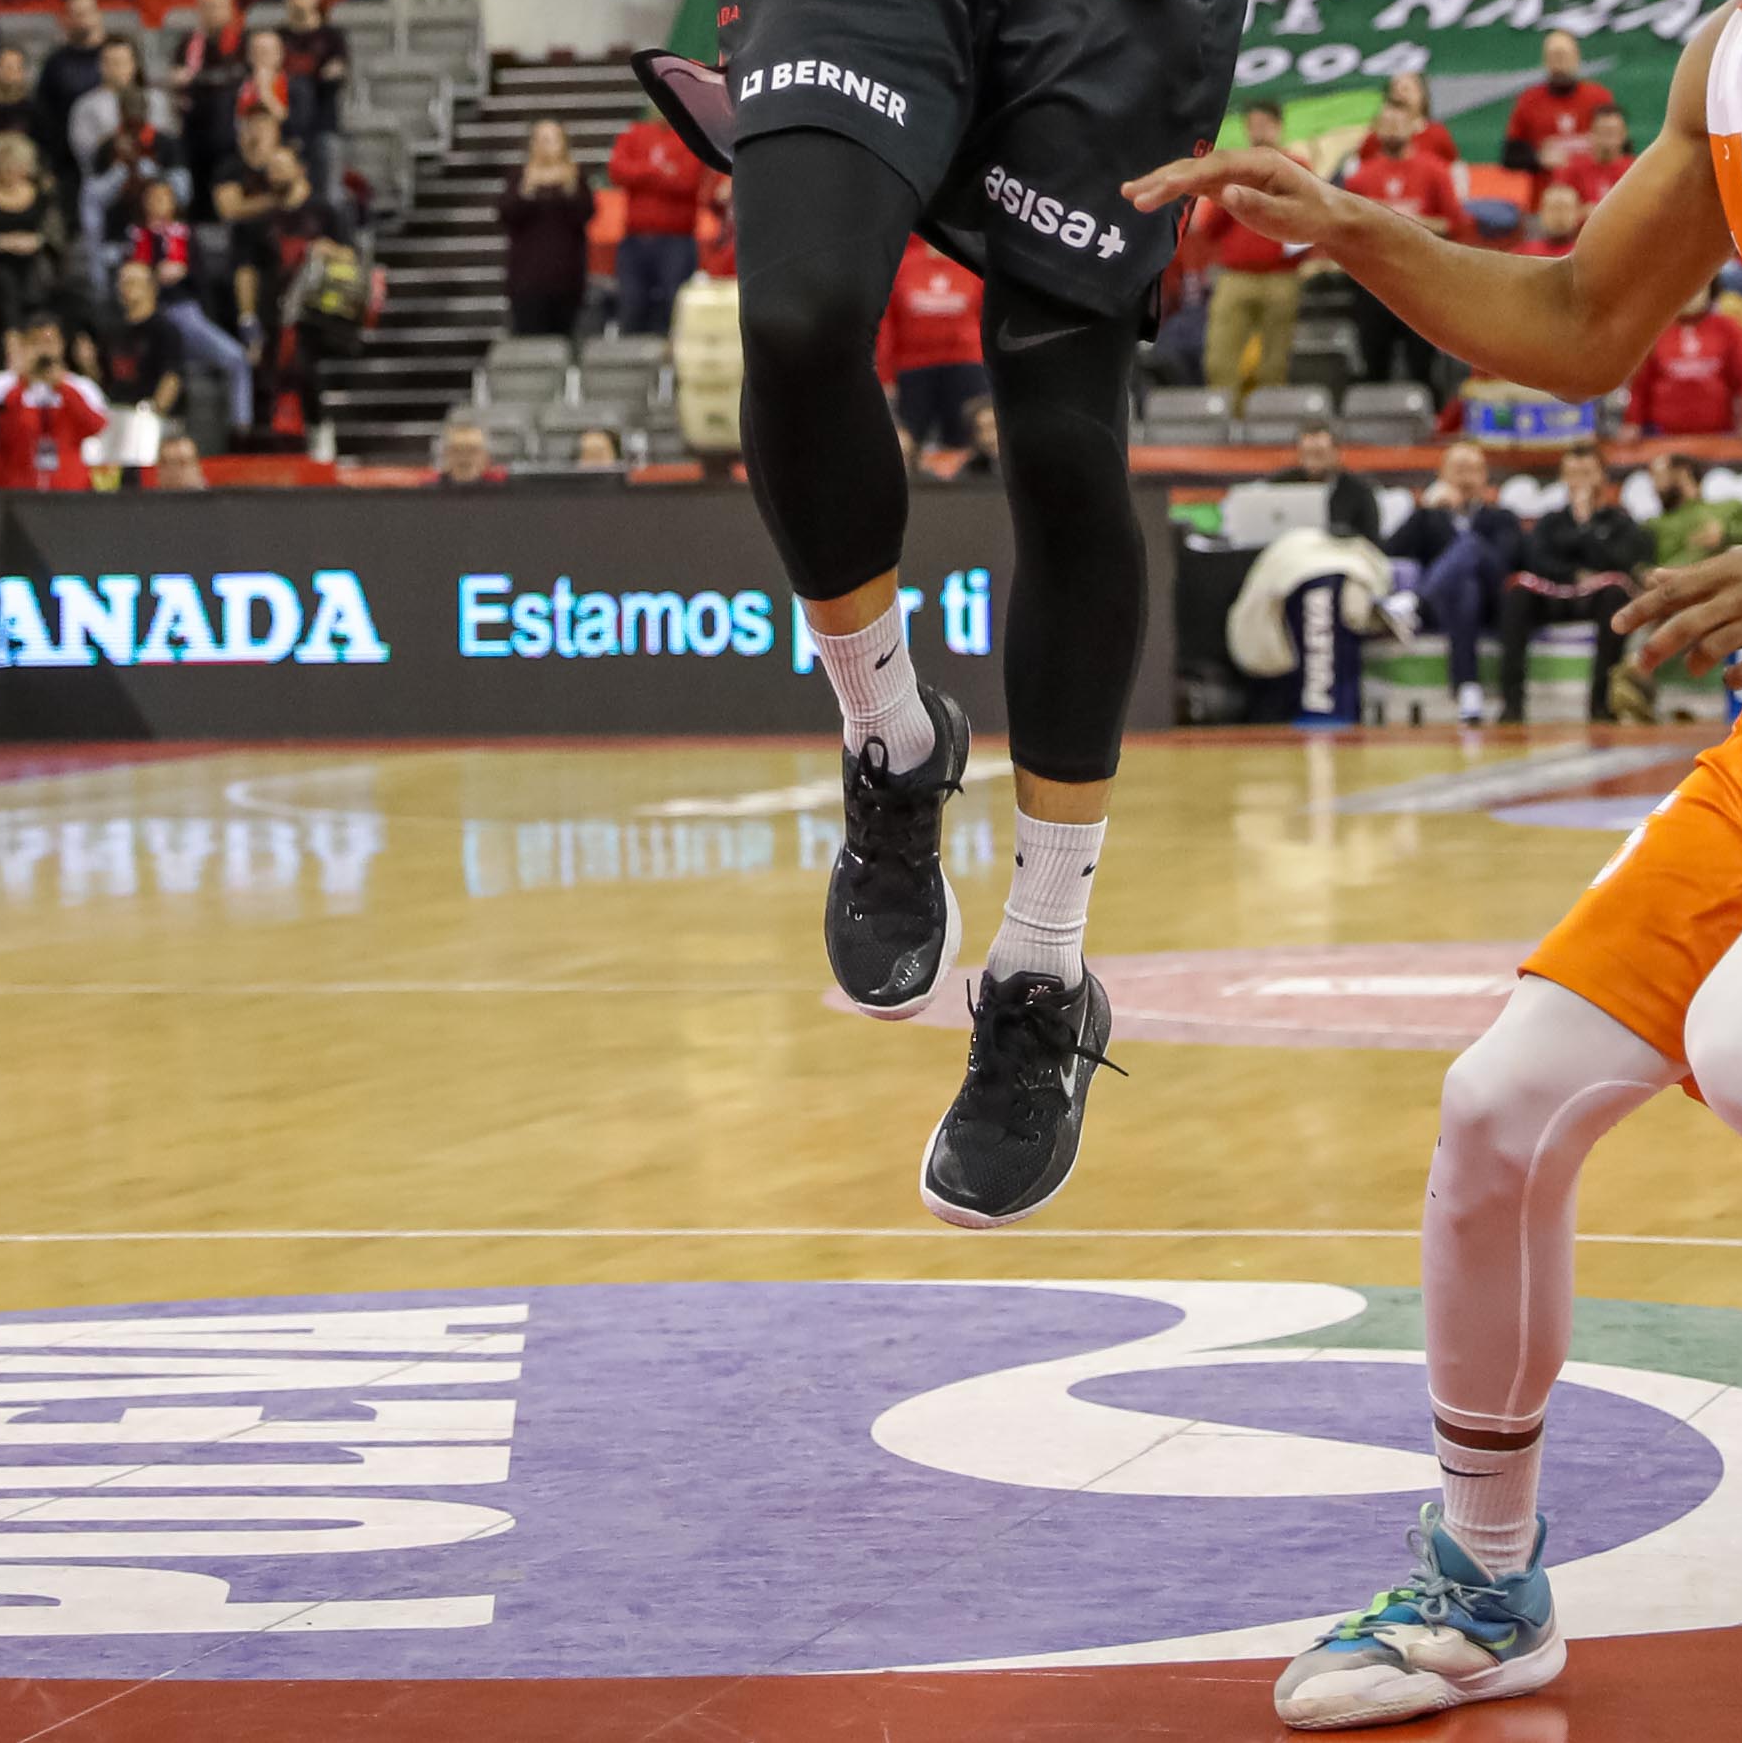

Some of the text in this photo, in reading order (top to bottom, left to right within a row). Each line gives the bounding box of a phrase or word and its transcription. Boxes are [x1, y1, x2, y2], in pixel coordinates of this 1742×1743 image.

[770, 60, 907, 127] BERNER
[457, 572, 775, 658] Estamos
[940, 567, 992, 655] ti
